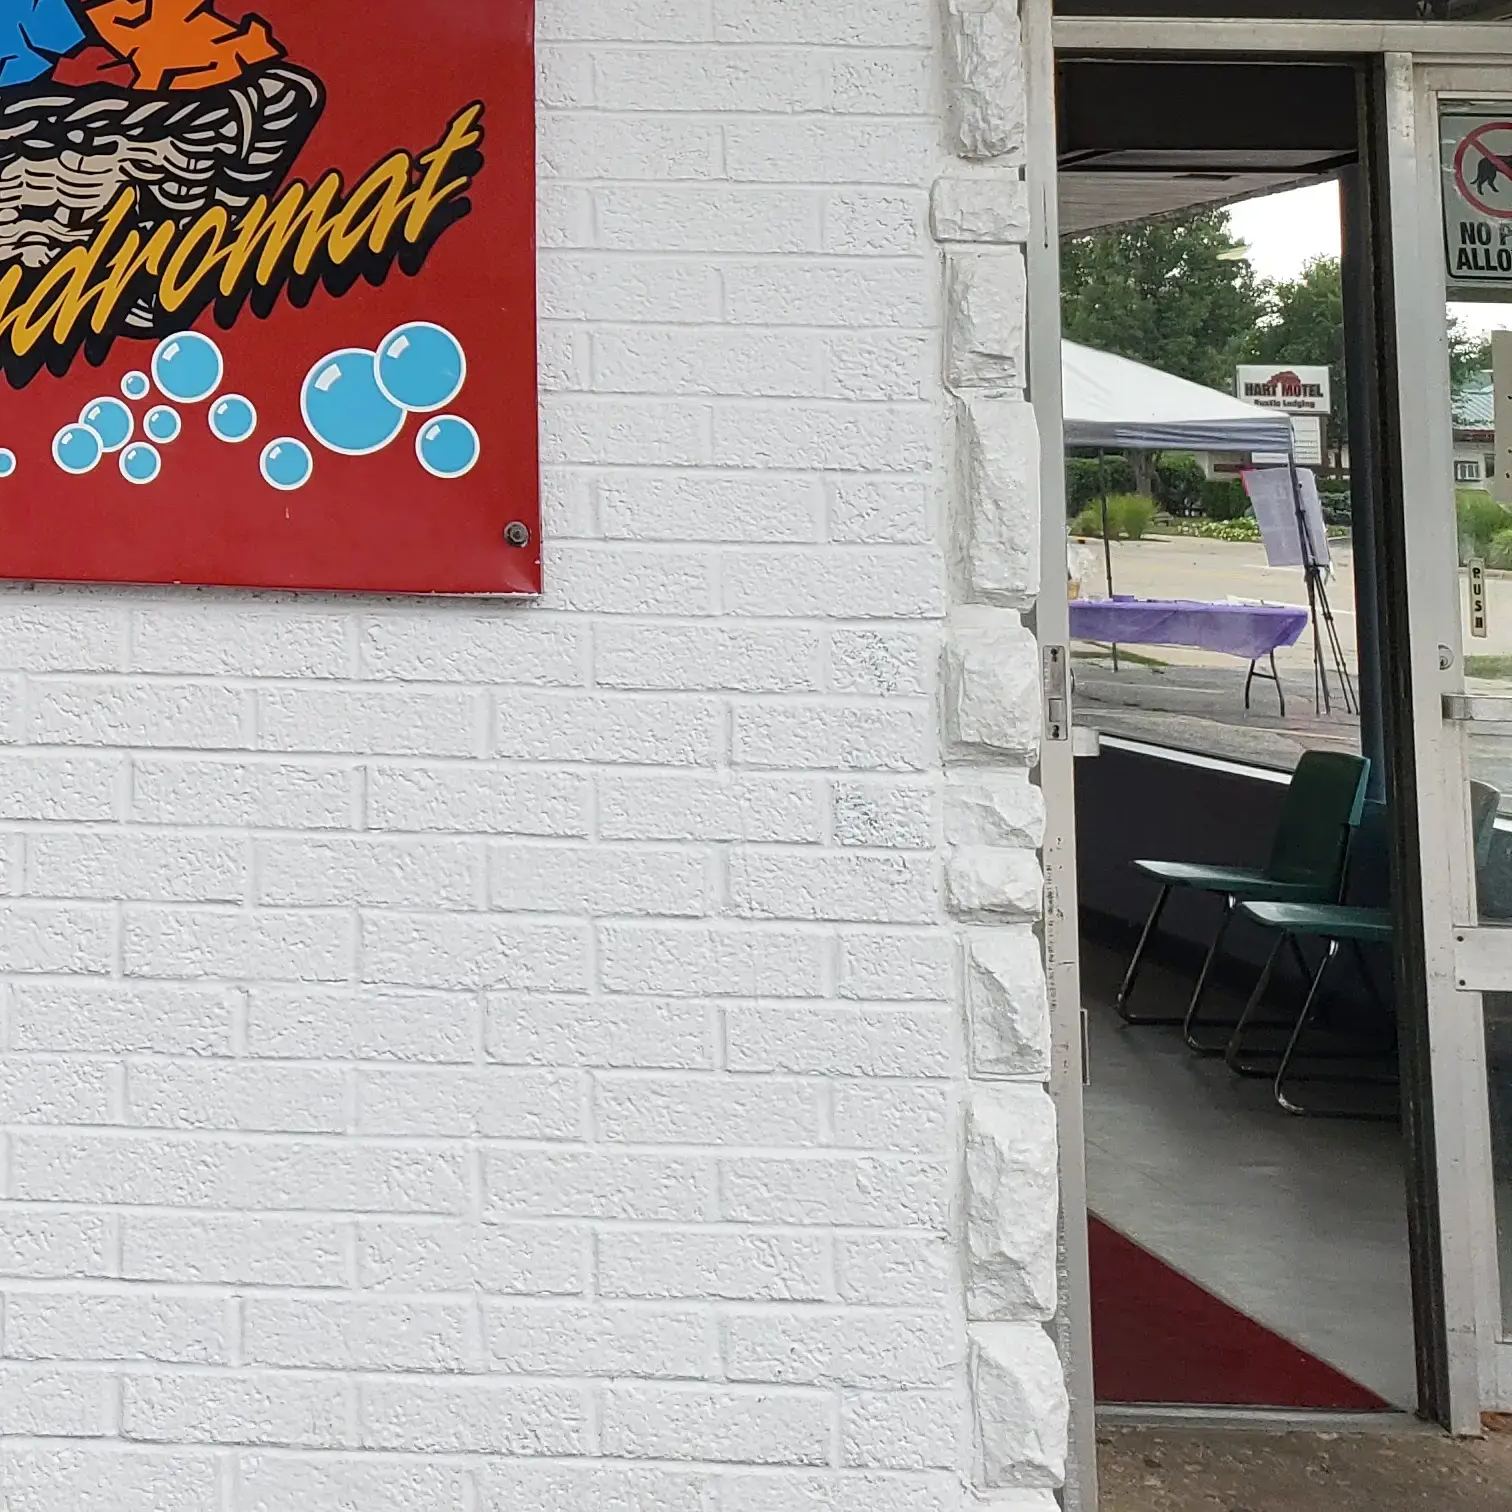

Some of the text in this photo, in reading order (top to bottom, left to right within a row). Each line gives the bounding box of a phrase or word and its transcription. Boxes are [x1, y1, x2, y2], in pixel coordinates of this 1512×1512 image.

[1459, 221, 1492, 246] NO
[1456, 247, 1512, 272] ALLO
[1244, 382, 1324, 398] HART MOTEL
[1472, 567, 1483, 629] PUSH
